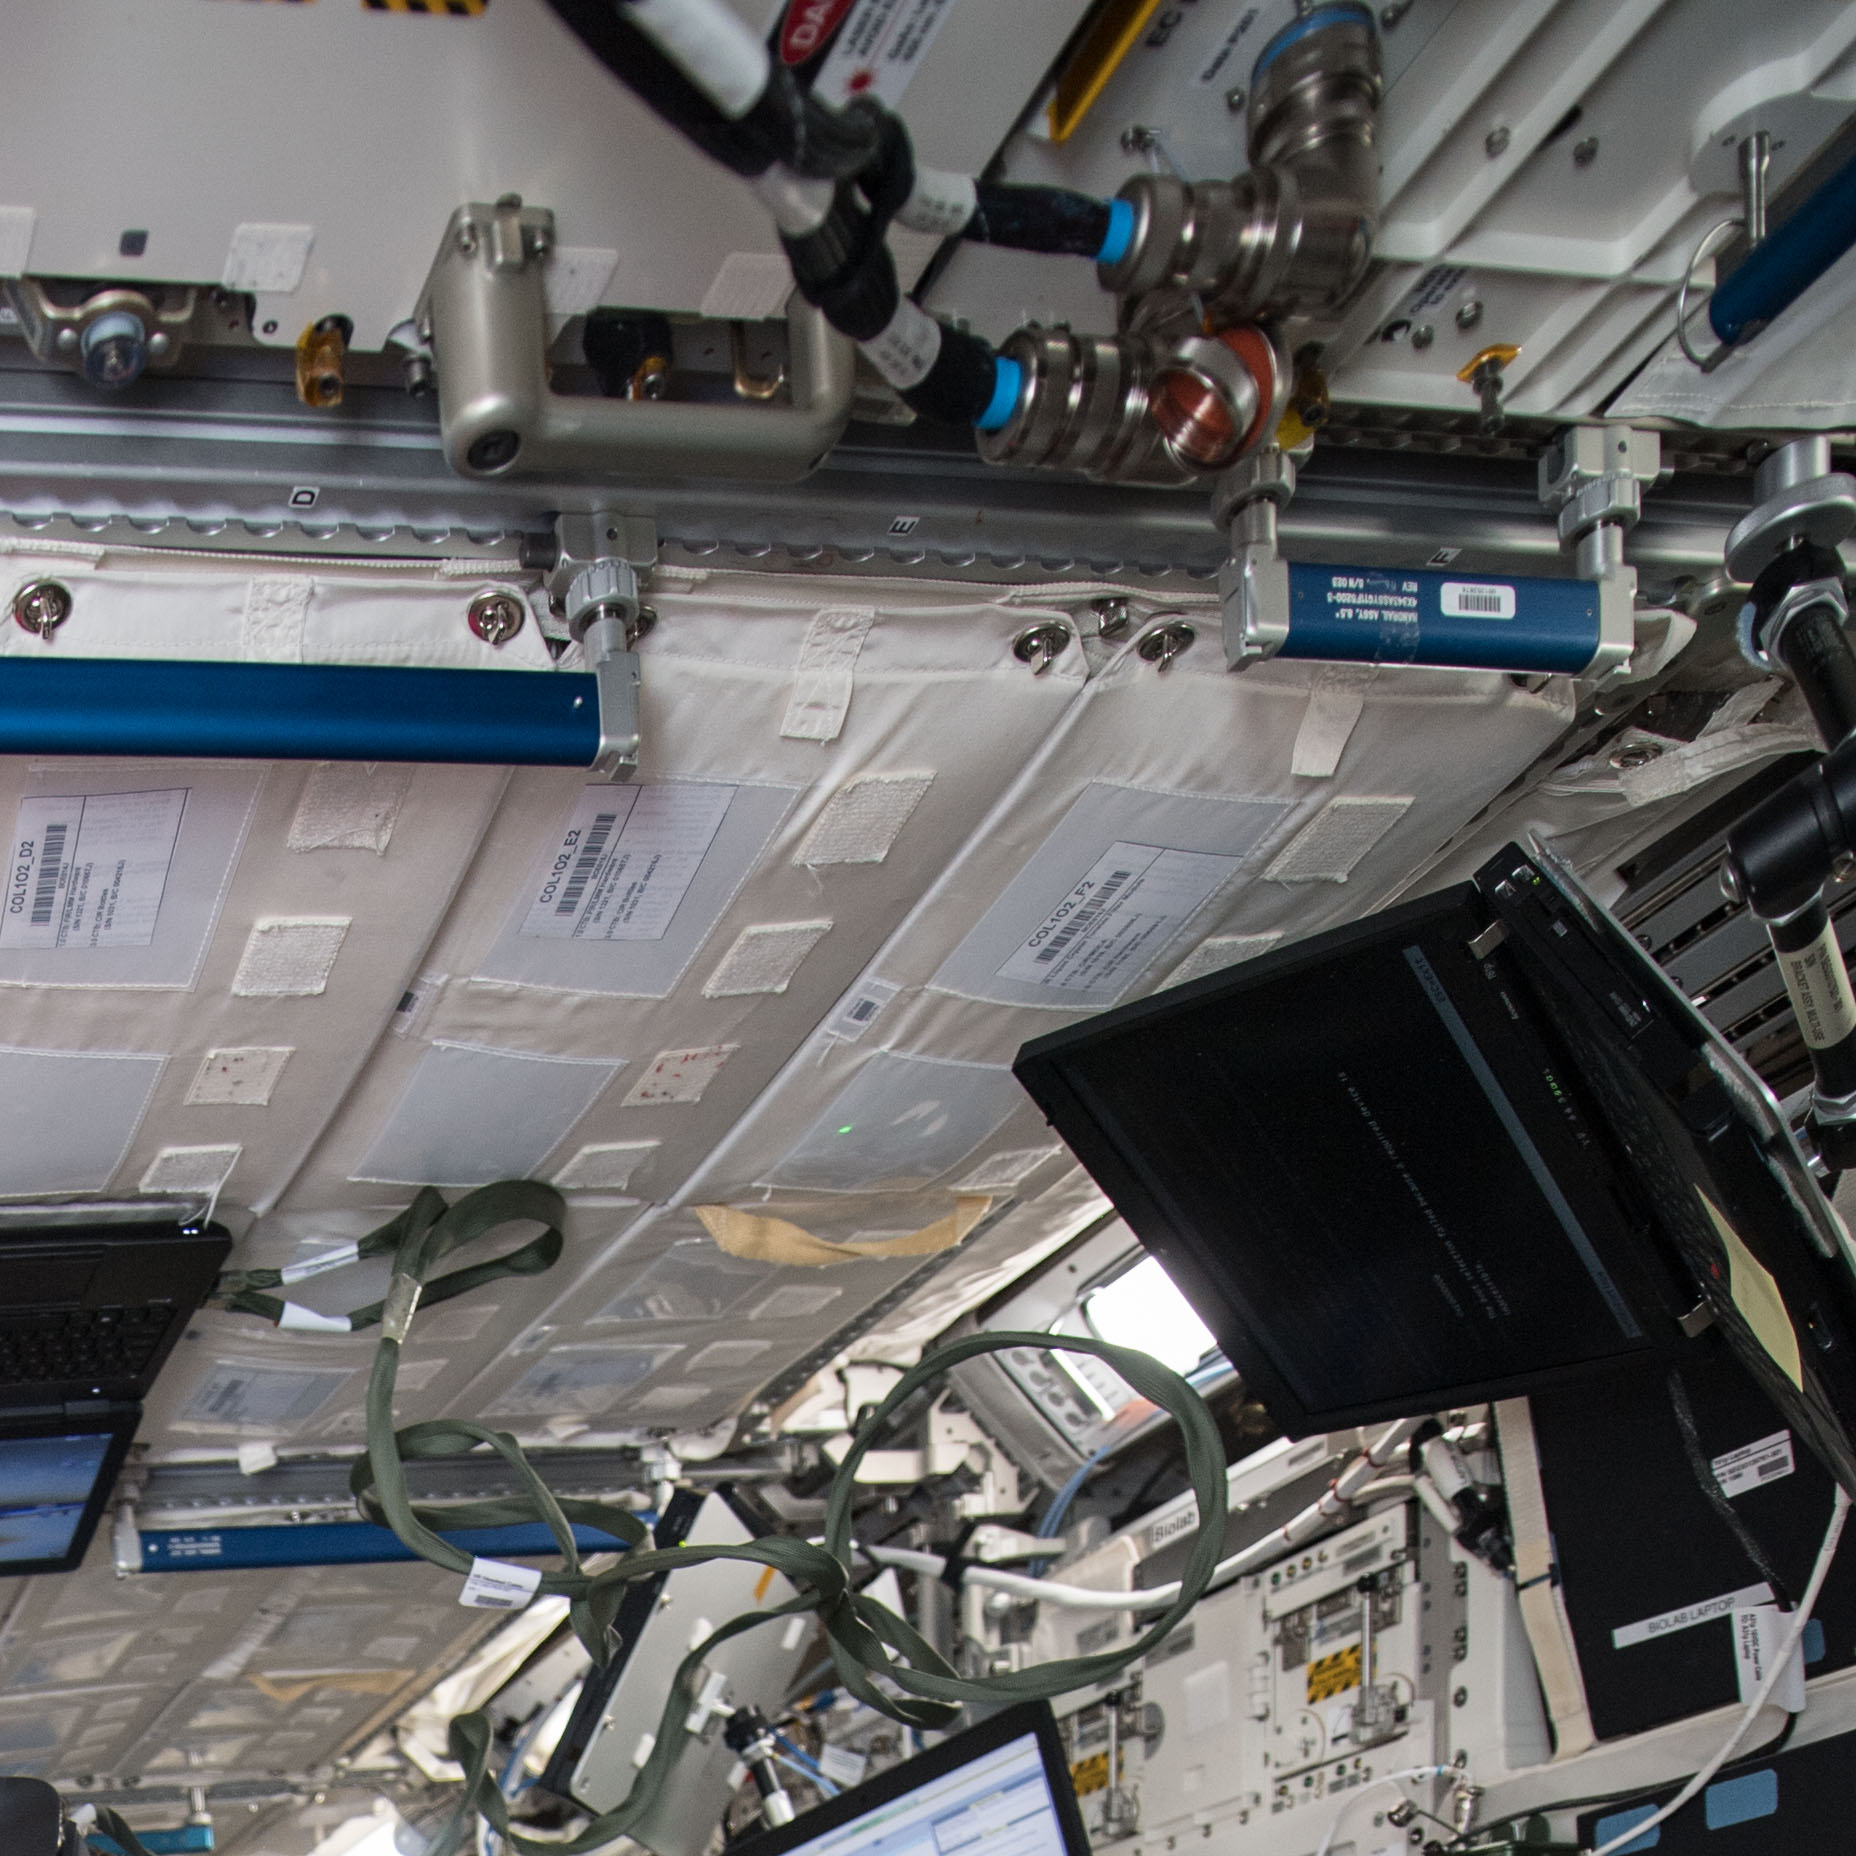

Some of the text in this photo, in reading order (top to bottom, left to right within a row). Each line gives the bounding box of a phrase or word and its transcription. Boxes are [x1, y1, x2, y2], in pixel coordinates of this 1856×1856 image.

[291, 489, 316, 506] D
[889, 519, 916, 534] E
[1430, 550, 1449, 564] F
[1150, 1507, 1197, 1544] Biolab
[1646, 1595, 1737, 1633] BIOLAB LAPTOP
